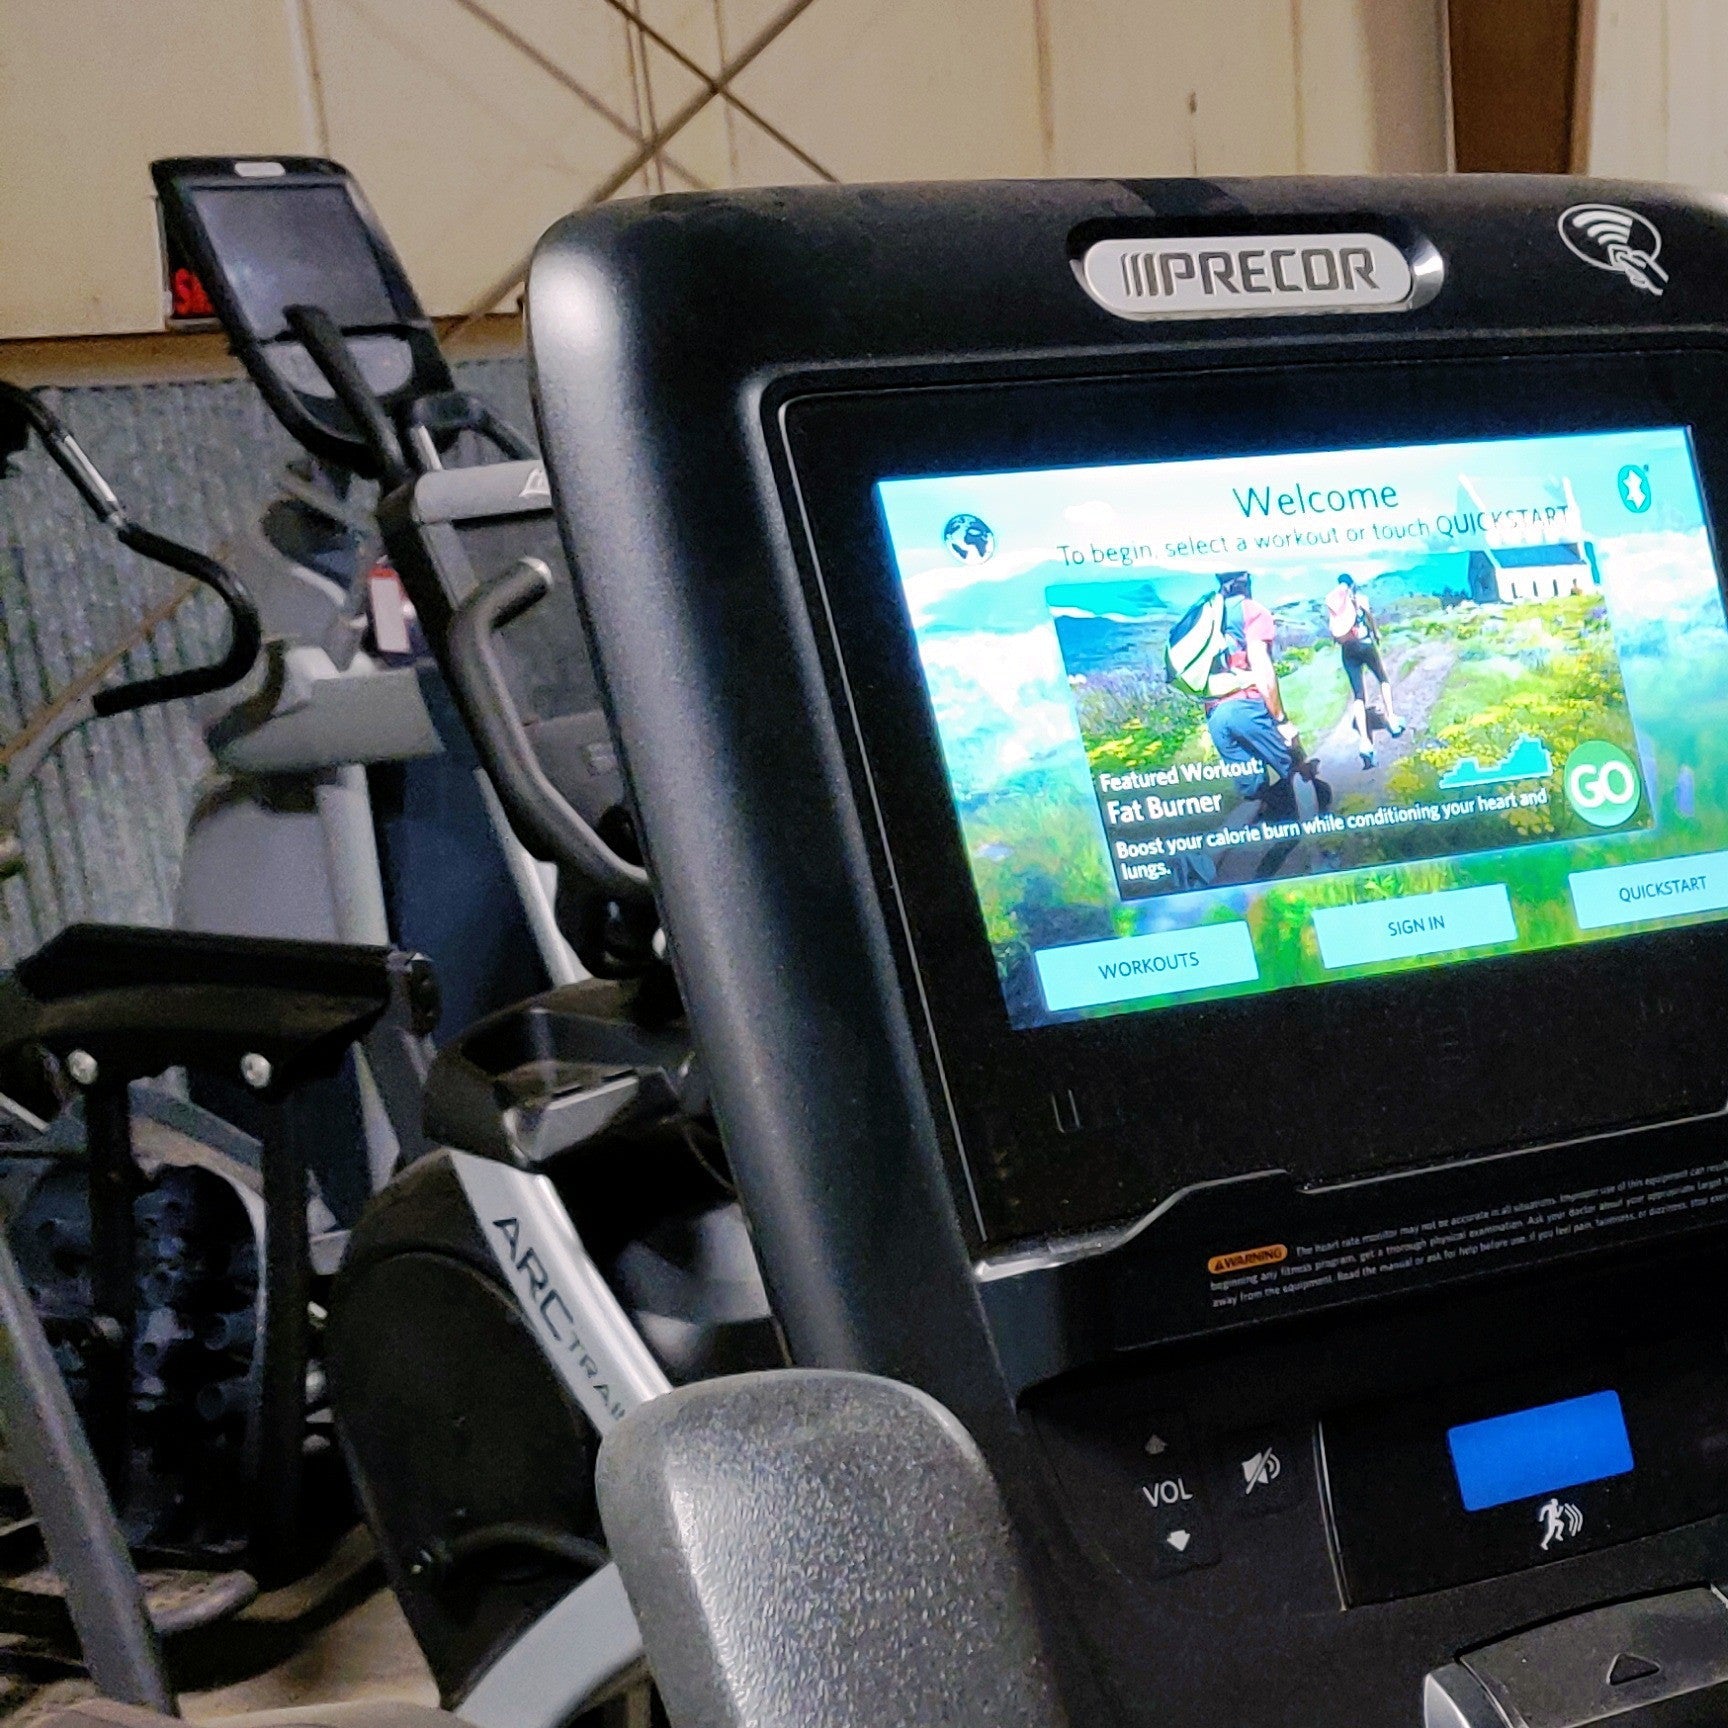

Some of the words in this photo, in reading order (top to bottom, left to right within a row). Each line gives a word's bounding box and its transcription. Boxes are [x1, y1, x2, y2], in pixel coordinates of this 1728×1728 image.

[1158, 246, 1380, 298] PRECOR
[1232, 483, 1399, 518] Welcome
[1057, 545, 1085, 566] To
[1165, 535, 1229, 558] select
[1236, 537, 1248, 551] a
[1255, 527, 1339, 549] workout
[1346, 526, 1365, 542] or
[1372, 518, 1430, 540] touch
[1436, 504, 1569, 539] QUICKSTART
[1099, 766, 1179, 793] Featured
[1181, 757, 1265, 782] Workout:
[1571, 760, 1635, 809] GO
[1106, 800, 1145, 824] Fat
[1146, 793, 1223, 820] Burner
[1115, 837, 1163, 859] Boost
[1166, 834, 1203, 855] your
[1206, 825, 1261, 848] calorie
[1263, 822, 1300, 840] burn
[1302, 810, 1345, 835] while
[1347, 801, 1441, 829] conditioning
[1442, 802, 1475, 822] your
[1478, 793, 1517, 812] heart
[1519, 787, 1548, 807] and
[1122, 860, 1172, 881] lungs.
[1619, 876, 1707, 902] QUICKSTART
[1387, 918, 1425, 936] SIGN
[1430, 915, 1445, 931] IN
[1098, 952, 1200, 980] WORKOUTS
[1224, 1247, 1282, 1268] WARNING
[1142, 1478, 1194, 1507] VOL
